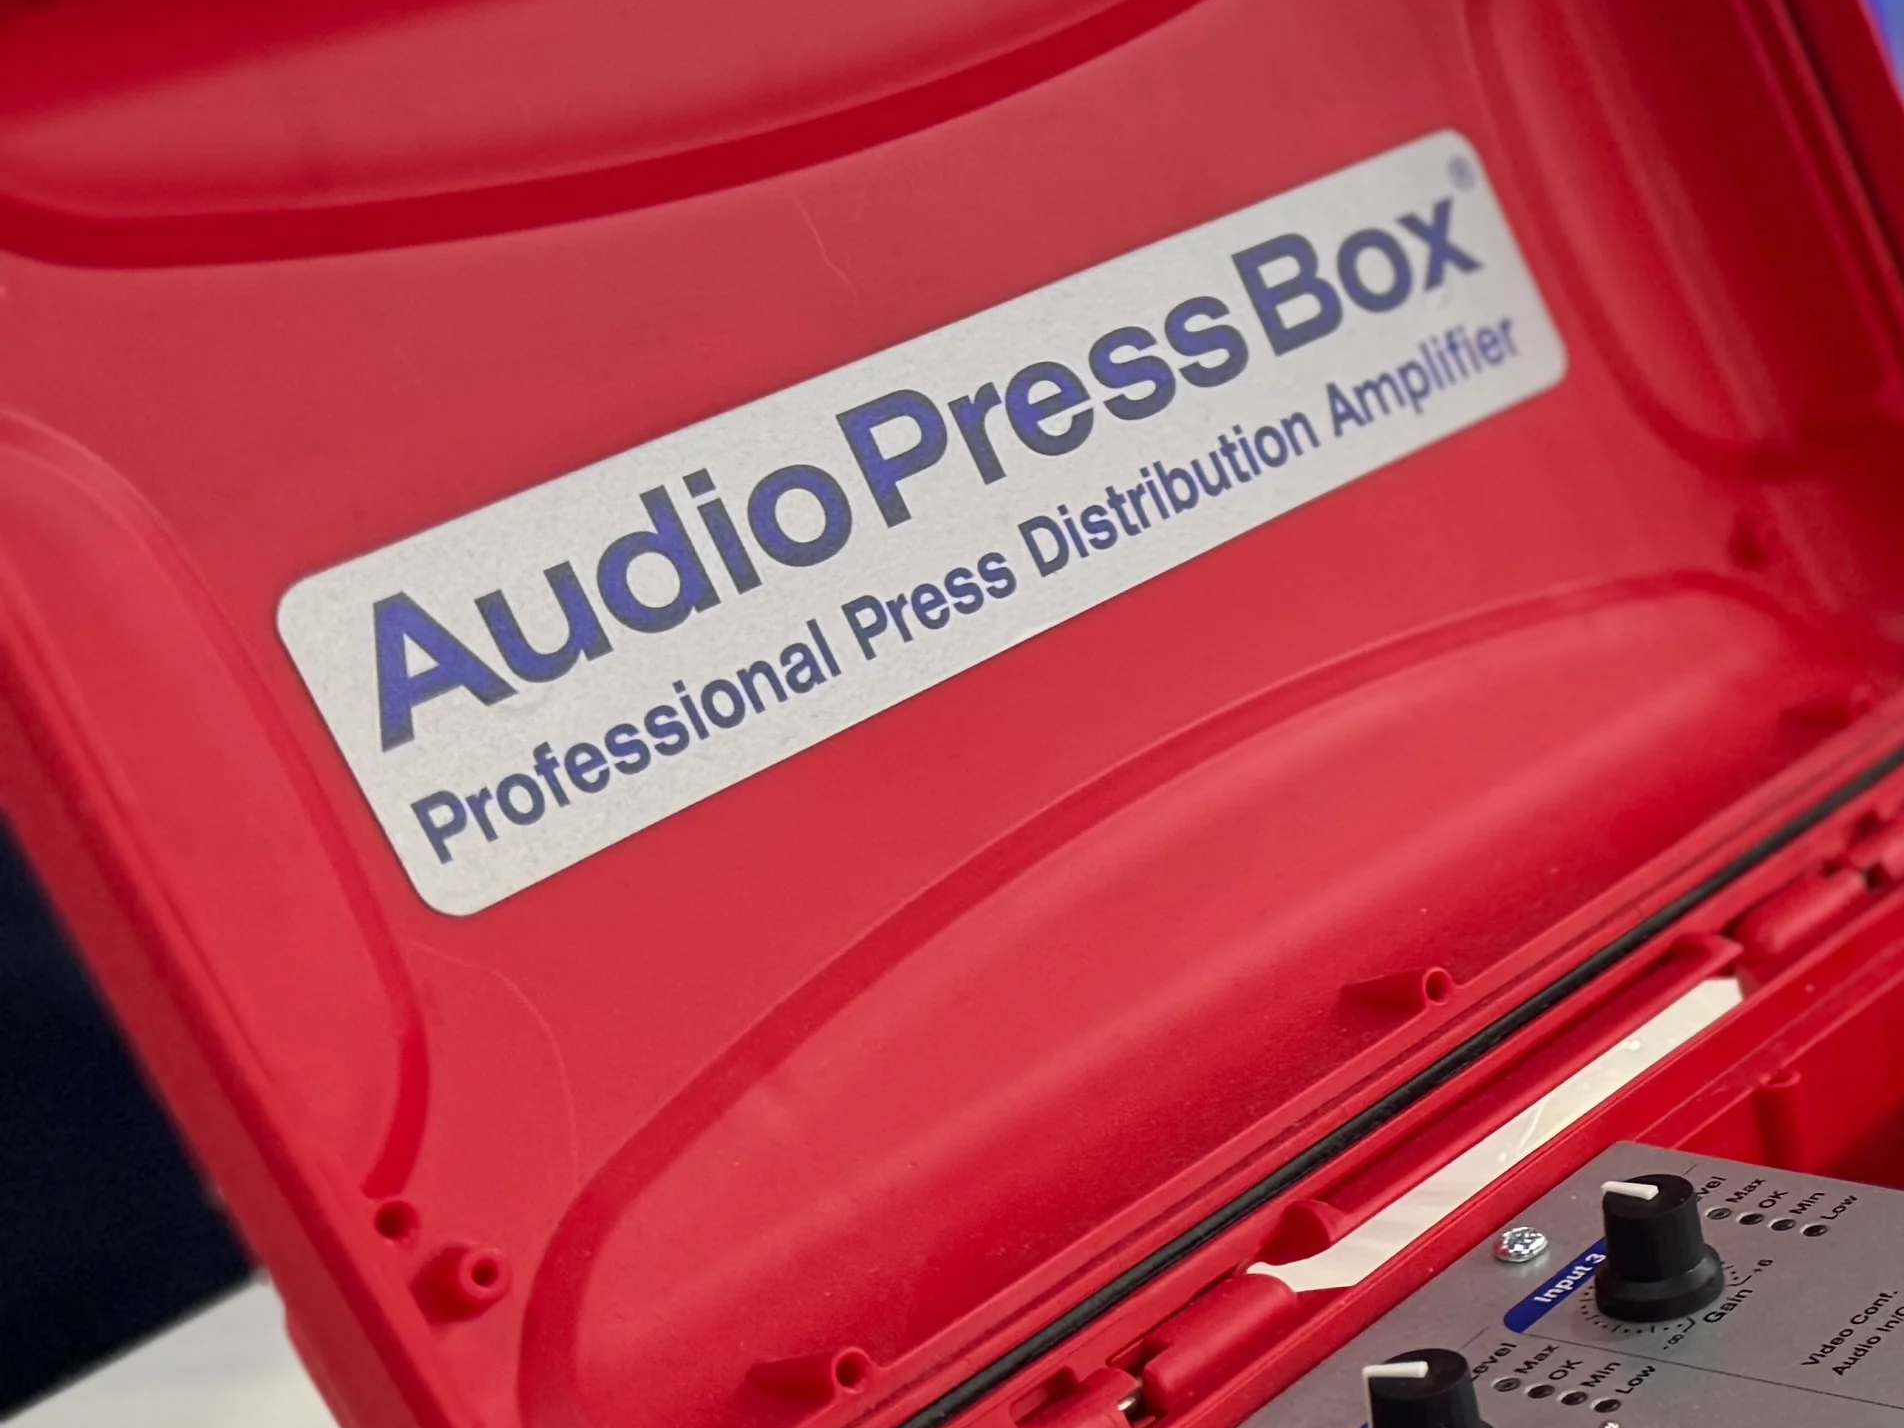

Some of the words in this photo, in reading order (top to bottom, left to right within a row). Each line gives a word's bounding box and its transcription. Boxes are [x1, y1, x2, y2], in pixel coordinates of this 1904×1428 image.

[372, 196, 1484, 753] AudioPressBox
[412, 619, 842, 865] Professional
[856, 542, 1017, 660] Press
[1018, 405, 1320, 576] Distribution
[1329, 314, 1519, 438] Amplifier
[1726, 1178, 1766, 1203] Max
[1758, 1190, 1789, 1209] OK
[1789, 1191, 1825, 1214] Min
[1821, 1195, 1857, 1221] Low
[1533, 1264, 1592, 1305] Input
[1585, 1253, 1606, 1265] 3
[1703, 1288, 1753, 1324] Gain
[1802, 1328, 1853, 1368] Video
[1850, 1290, 1898, 1325] Conf.
[1513, 1344, 1559, 1374] Max
[1549, 1358, 1584, 1381] OK
[1832, 1334, 1881, 1375] Audio
[1581, 1361, 1621, 1388] Min
[1616, 1365, 1656, 1395] Low
